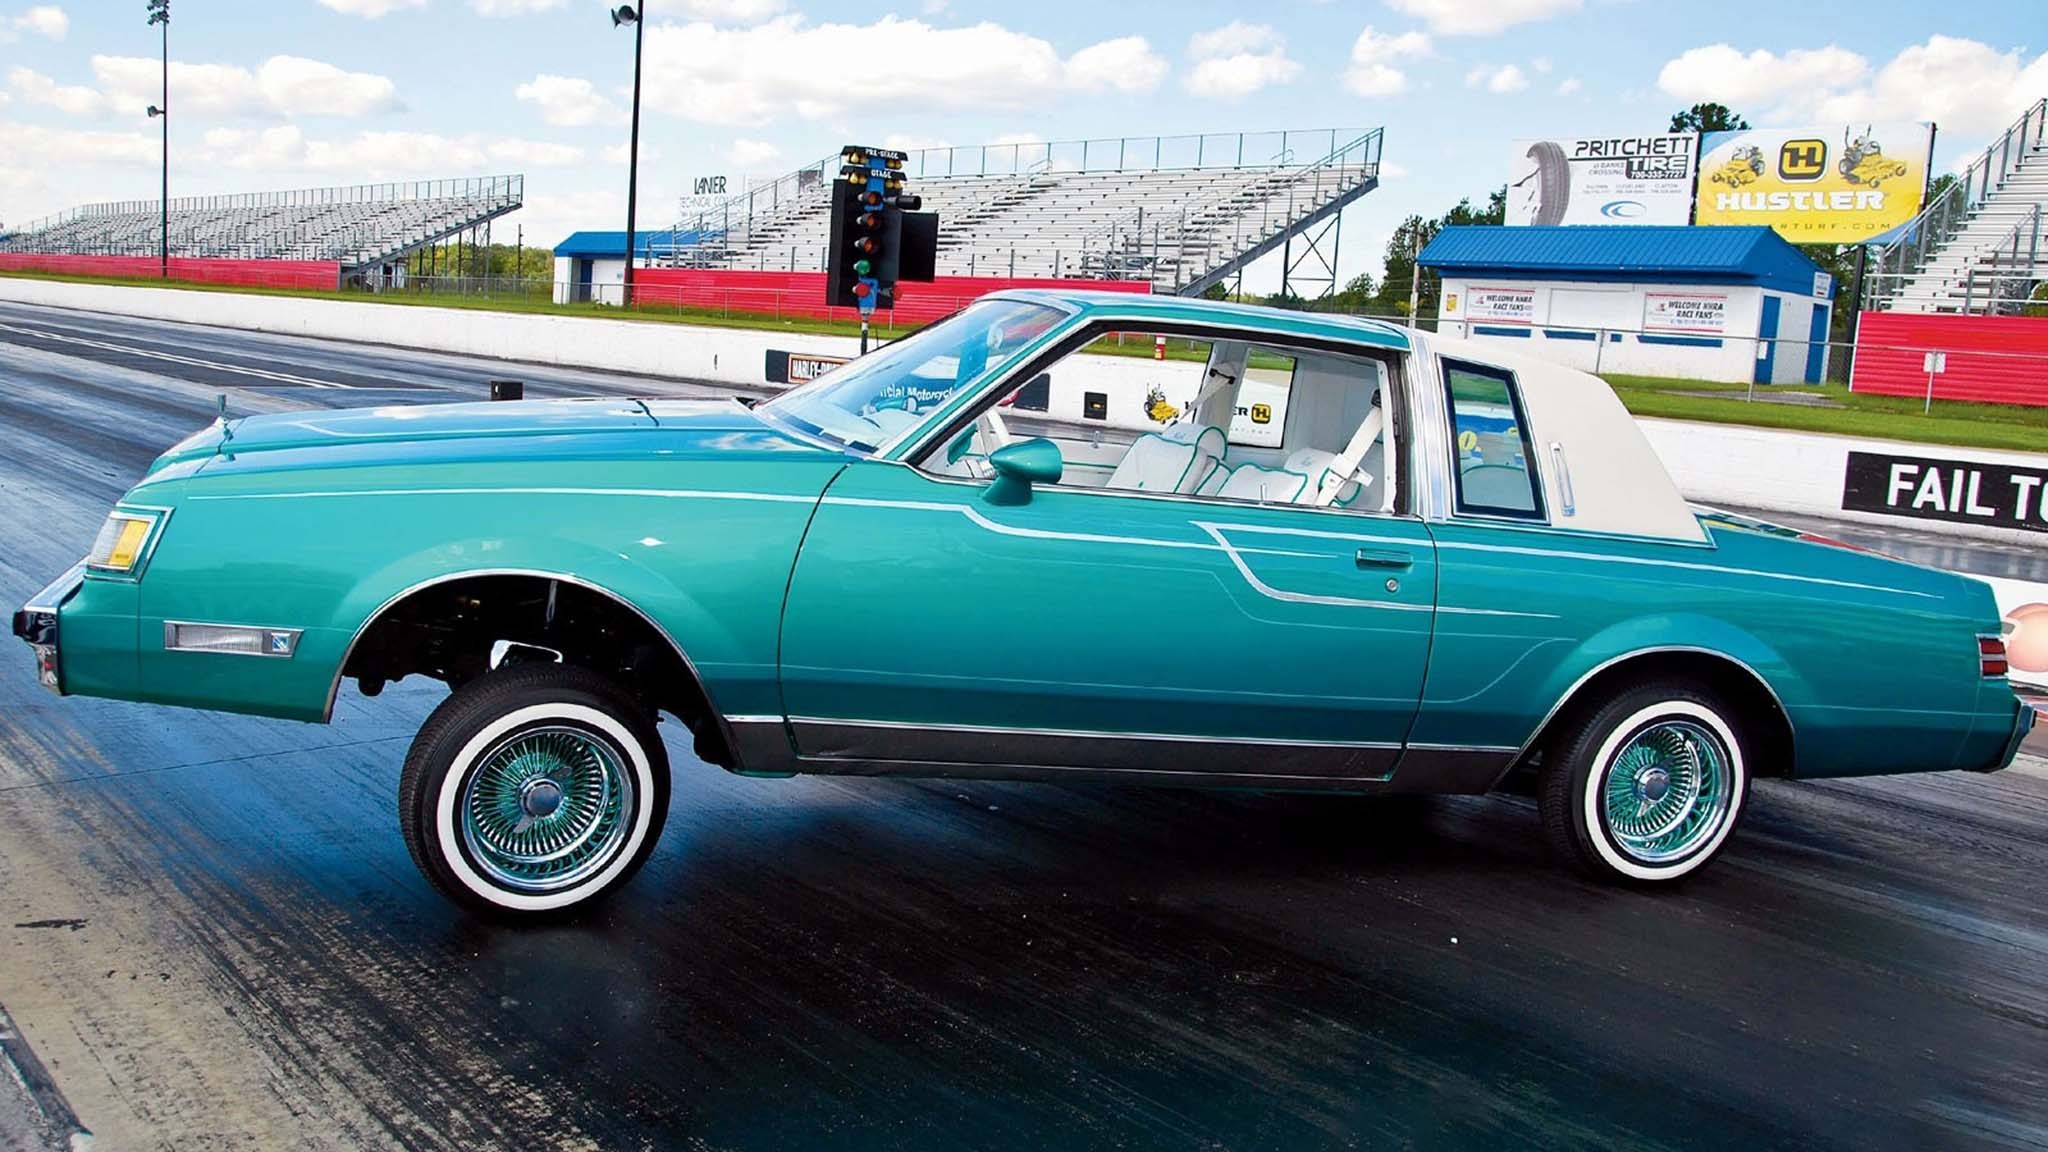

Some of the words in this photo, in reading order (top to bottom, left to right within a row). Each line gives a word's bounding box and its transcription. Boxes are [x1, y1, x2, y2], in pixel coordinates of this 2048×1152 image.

[1575, 137, 1693, 156] PRITCHETT
[864, 148, 899, 160] PRE-STAGE
[1628, 156, 1687, 172] TIRE
[870, 169, 892, 178] STAGE
[1716, 190, 1886, 212] HUSTLER
[1668, 300, 1702, 310] WELCOME
[1676, 310, 1693, 319] RACE
[1694, 311, 1713, 319] FANS
[1887, 463, 1996, 517] FAIL
